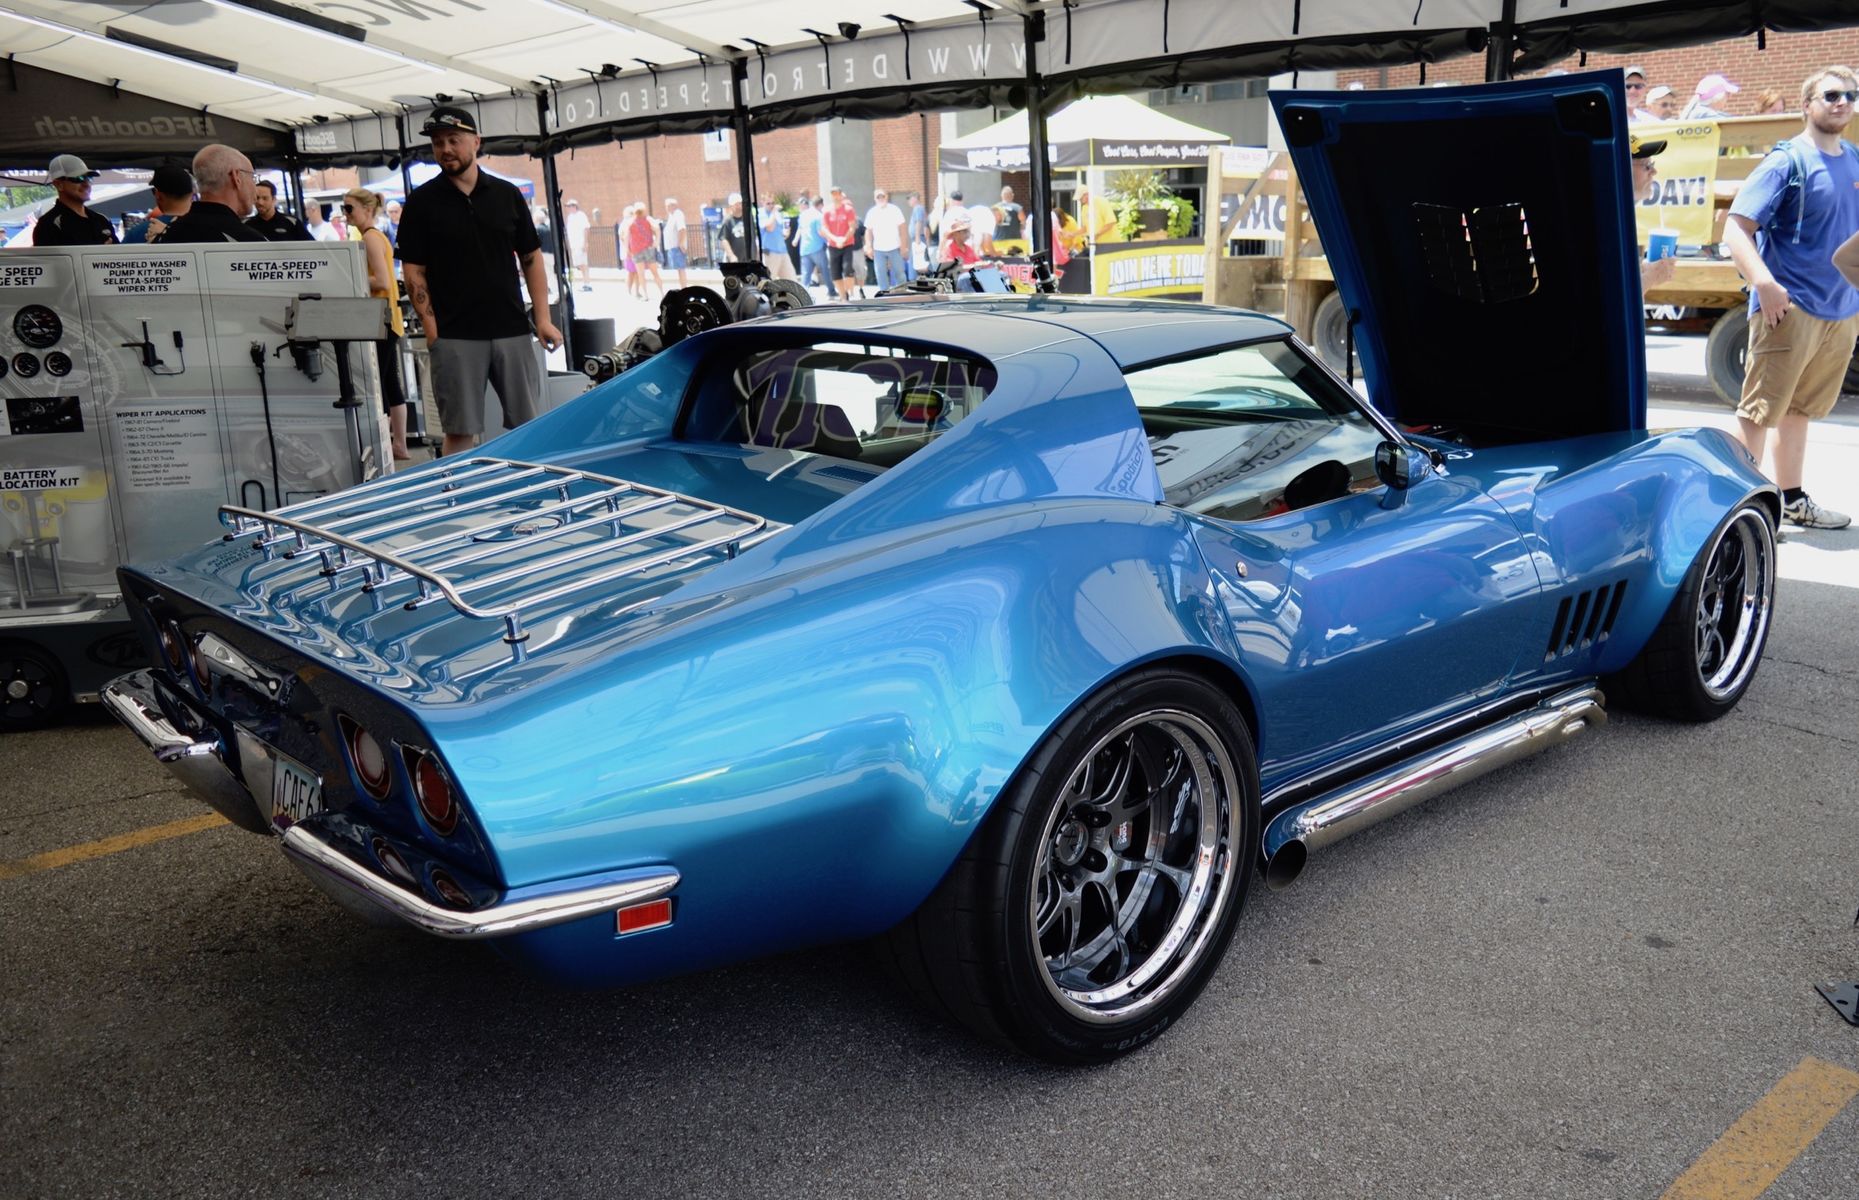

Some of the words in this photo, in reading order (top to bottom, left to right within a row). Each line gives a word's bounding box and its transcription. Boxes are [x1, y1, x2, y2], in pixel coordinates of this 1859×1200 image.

[92, 261, 148, 269] WINDSHIELD
[150, 260, 187, 268] WASHER
[5, 267, 43, 276] SPEED
[109, 269, 135, 277] PUMP
[155, 268, 172, 276] FOR
[248, 271, 283, 280] WIPER
[287, 270, 313, 279] KITS
[14, 277, 37, 286] SET
[118, 285, 146, 293] WIPER
[148, 284, 169, 292] KITS
[155, 408, 207, 416] APPLICATIONS
[4, 470, 57, 480] BATTERY
[0, 479, 57, 489] LOCATION
[60, 478, 80, 487] KIT
